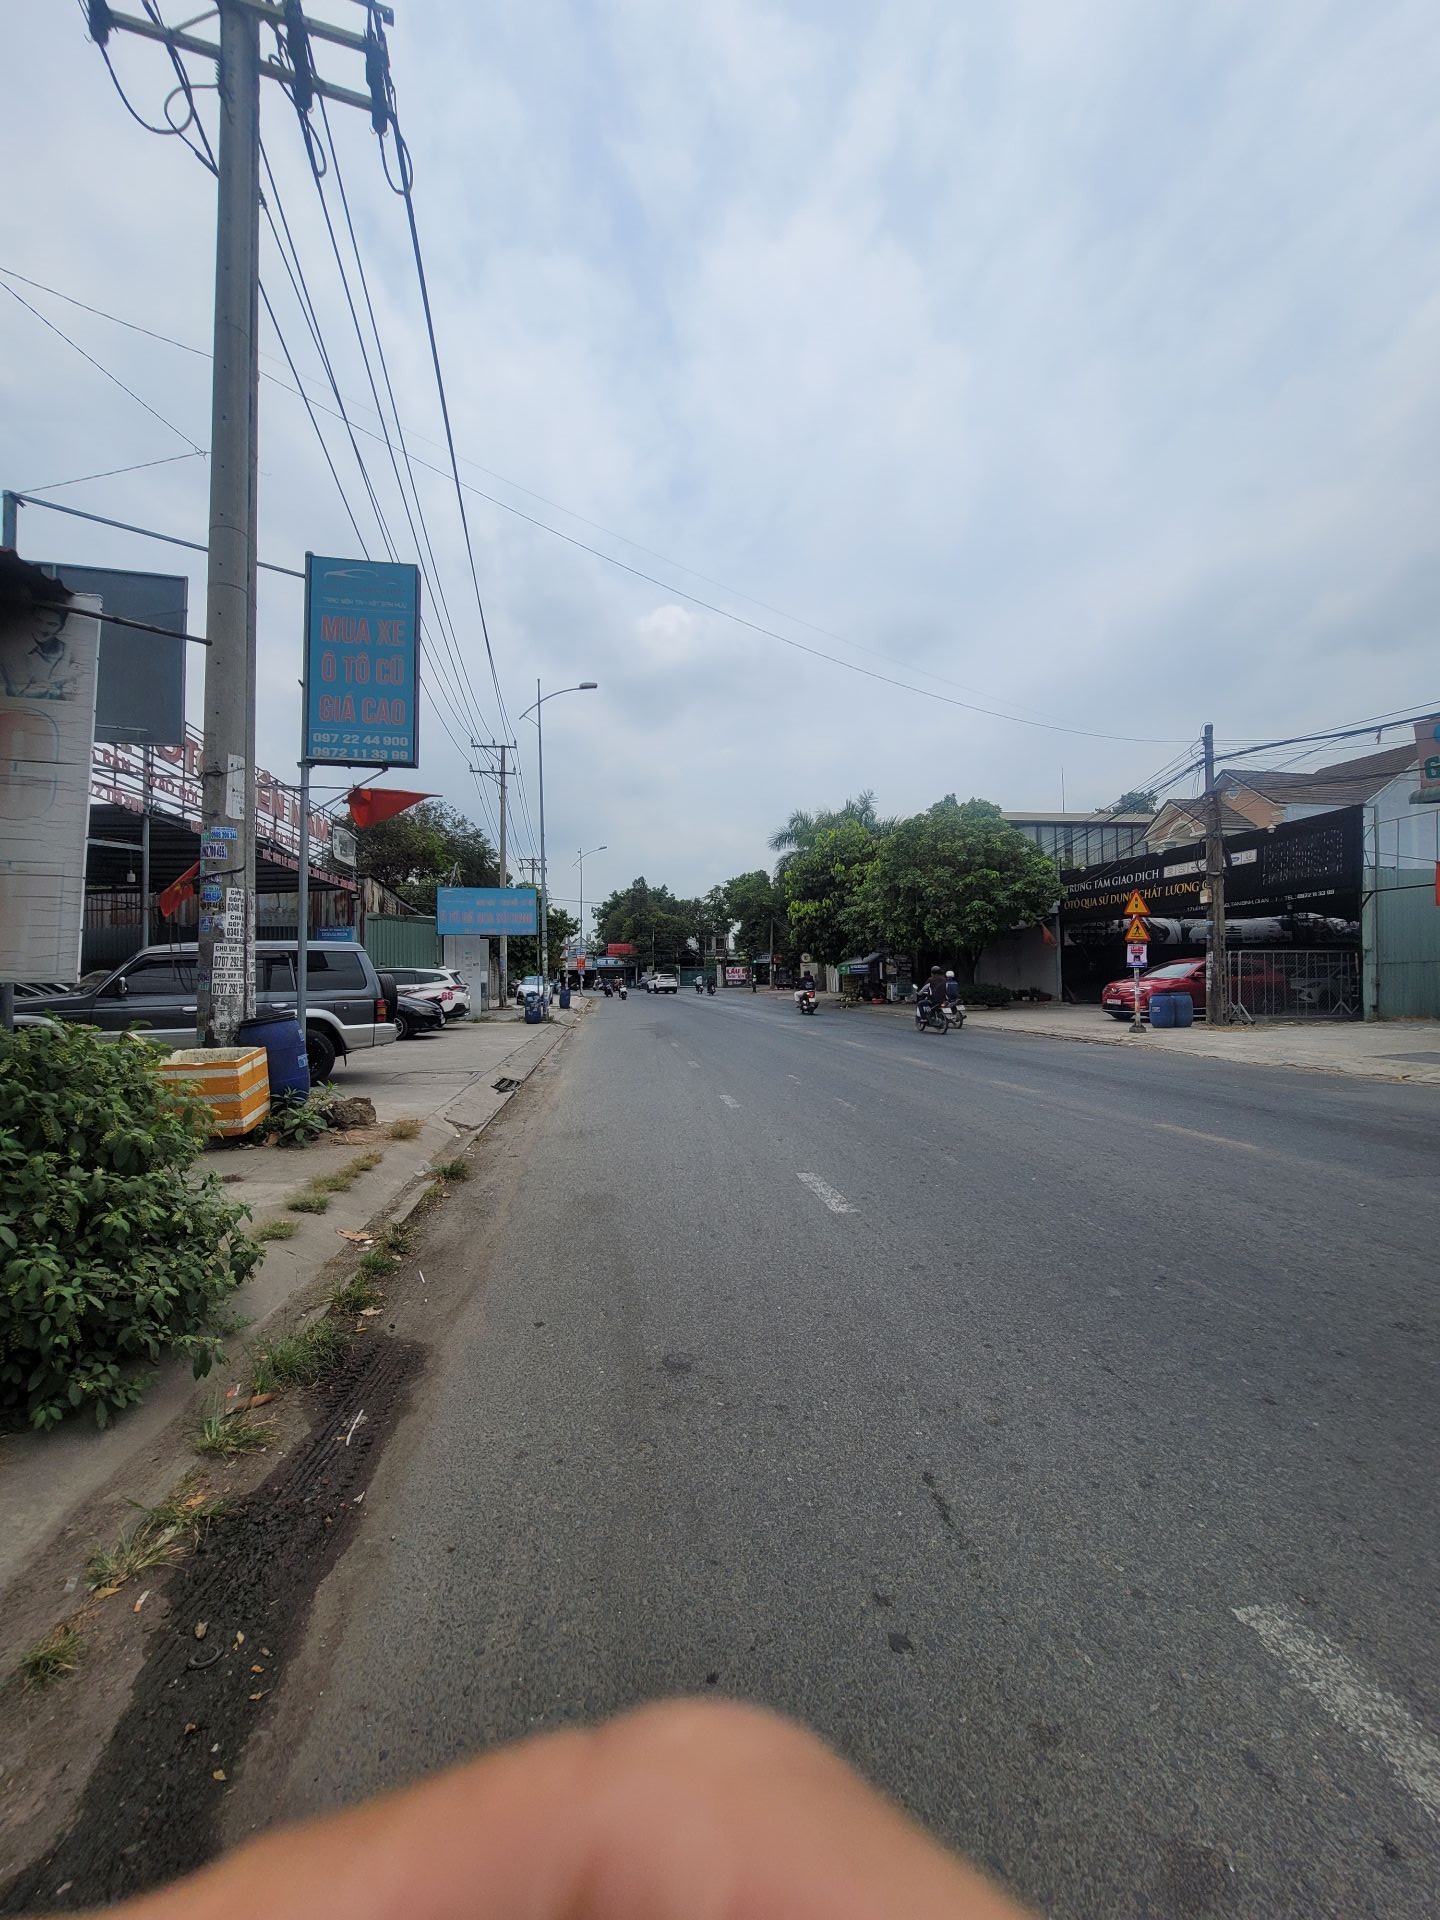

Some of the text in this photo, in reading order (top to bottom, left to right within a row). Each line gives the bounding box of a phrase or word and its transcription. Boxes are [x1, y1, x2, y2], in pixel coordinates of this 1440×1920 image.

[321, 615, 405, 647] MUA XE
[321, 650, 404, 686] Ô TÔ CŨ
[319, 690, 406, 726] GIÁ CAO
[312, 732, 409, 747] 097 22 44 900
[312, 747, 348, 757] 0972
[352, 748, 367, 758] 11
[371, 749, 387, 760] 33
[1094, 877, 1111, 889] TÂM
[1112, 873, 1134, 886] GIAO
[1135, 868, 1160, 883] DỊCH
[1081, 897, 1098, 909] QUA
[1110, 891, 1135, 905] DỤNG
[1140, 882, 1163, 900] CHẤT
[1165, 880, 1200, 897] LƯỢNG
[214, 956, 228, 967] 0707
[212, 983, 227, 994] 0707
